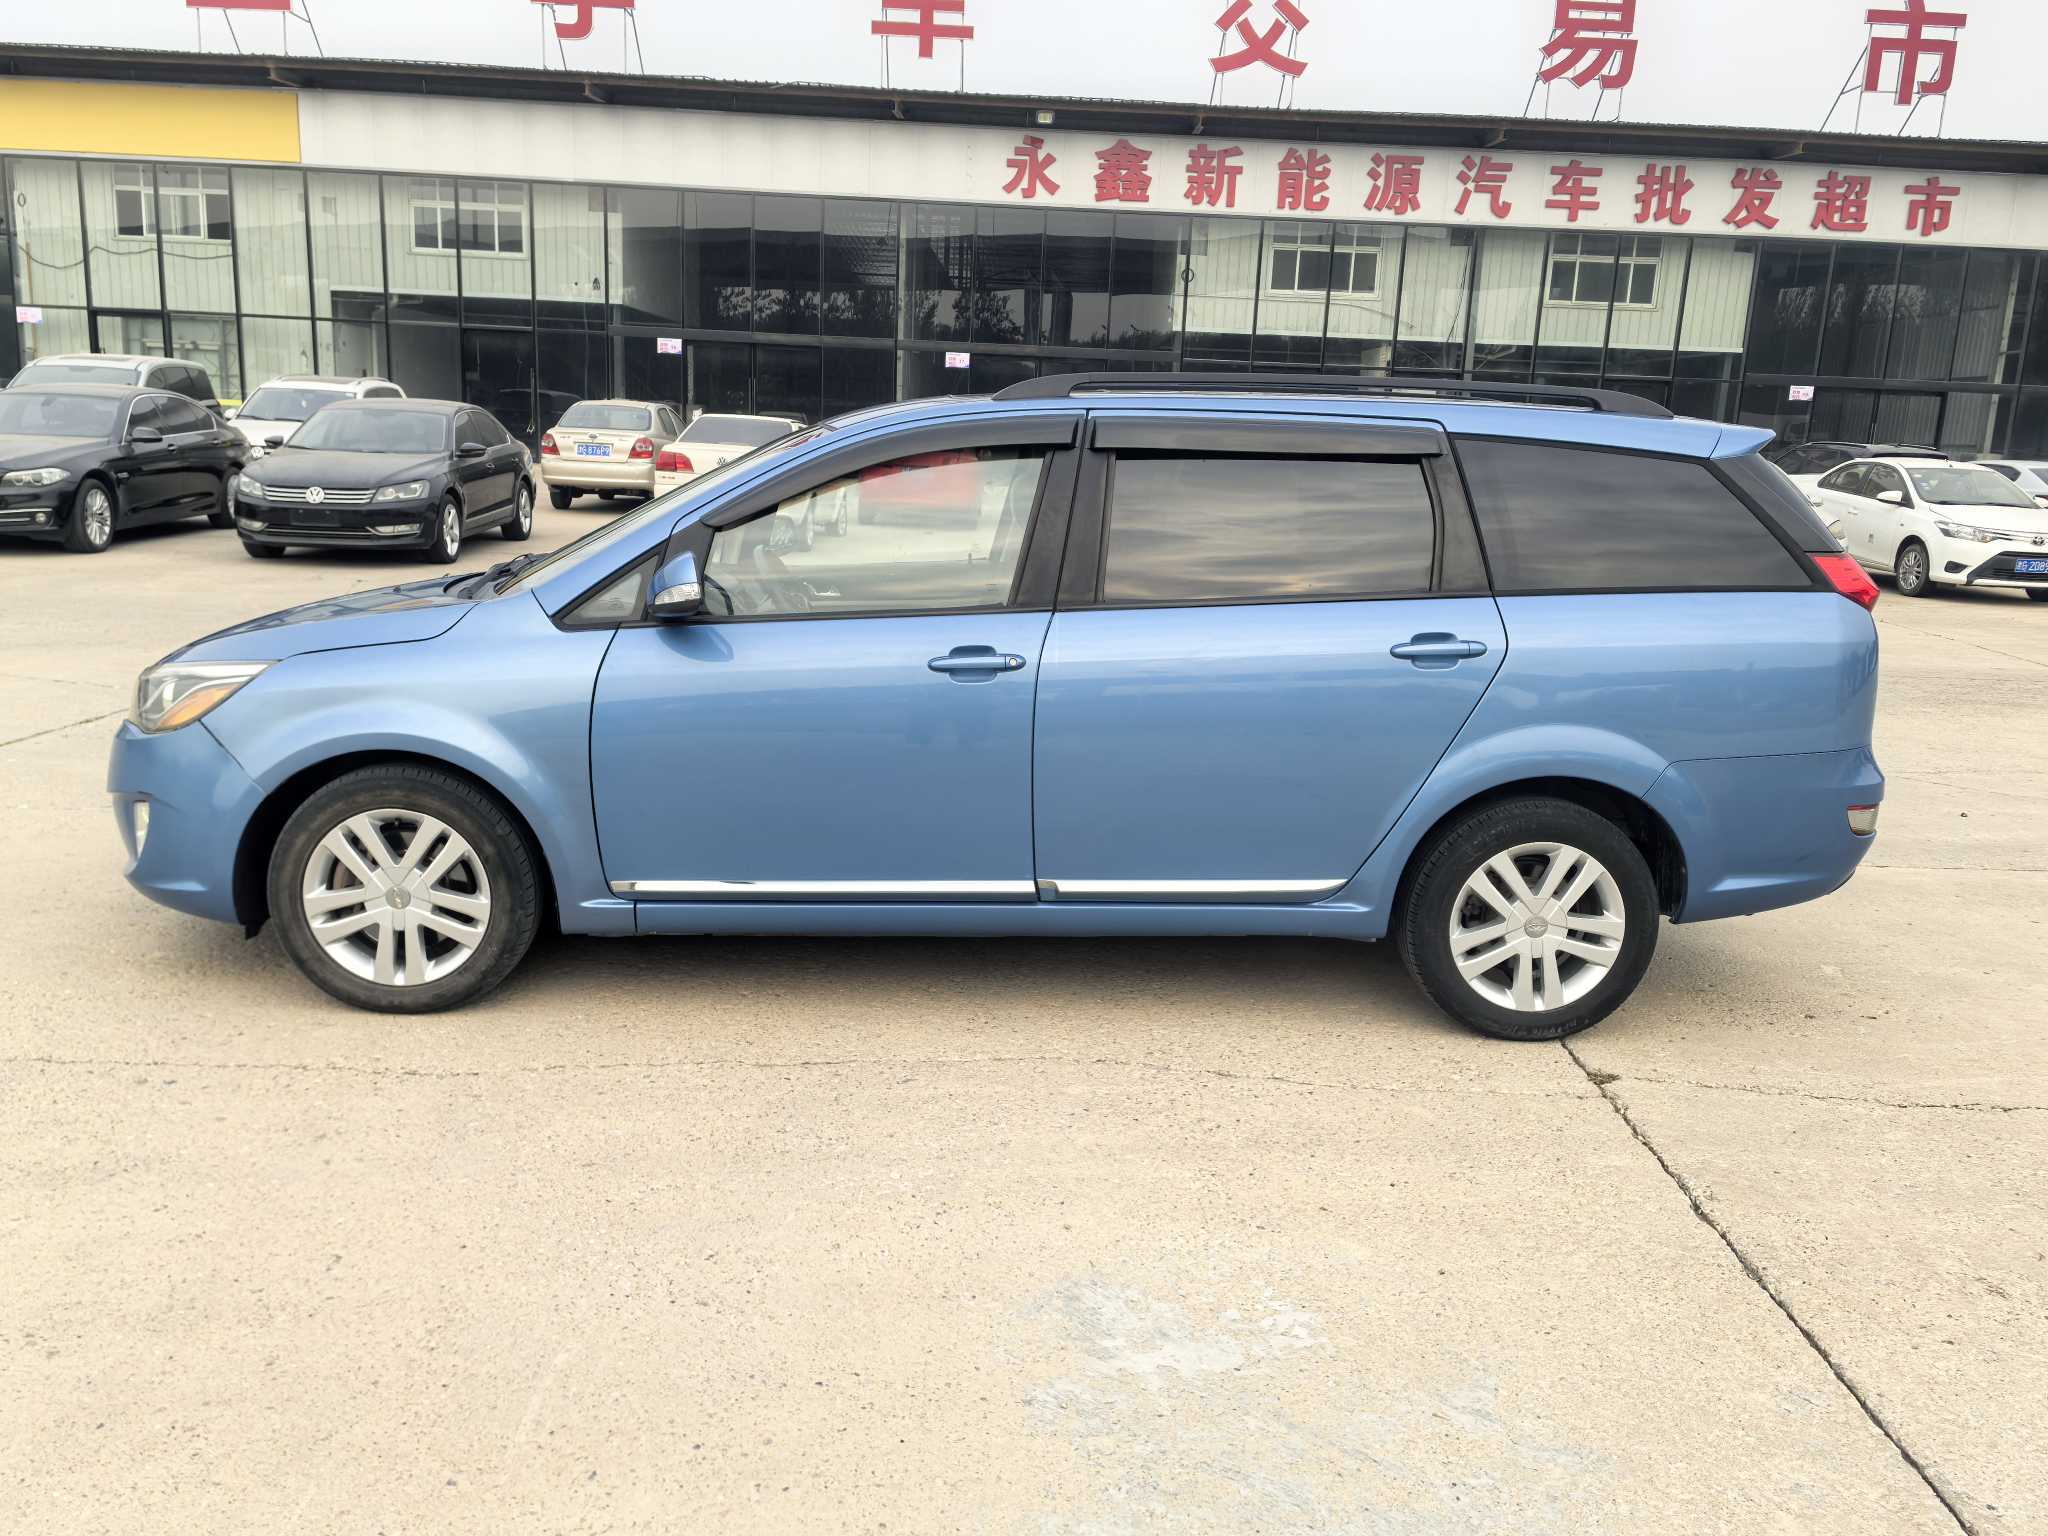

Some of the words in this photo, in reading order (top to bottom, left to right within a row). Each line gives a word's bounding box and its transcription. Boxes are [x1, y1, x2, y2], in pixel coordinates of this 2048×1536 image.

[1002, 134, 1962, 237] 永鑫新能源汽车批发超市
